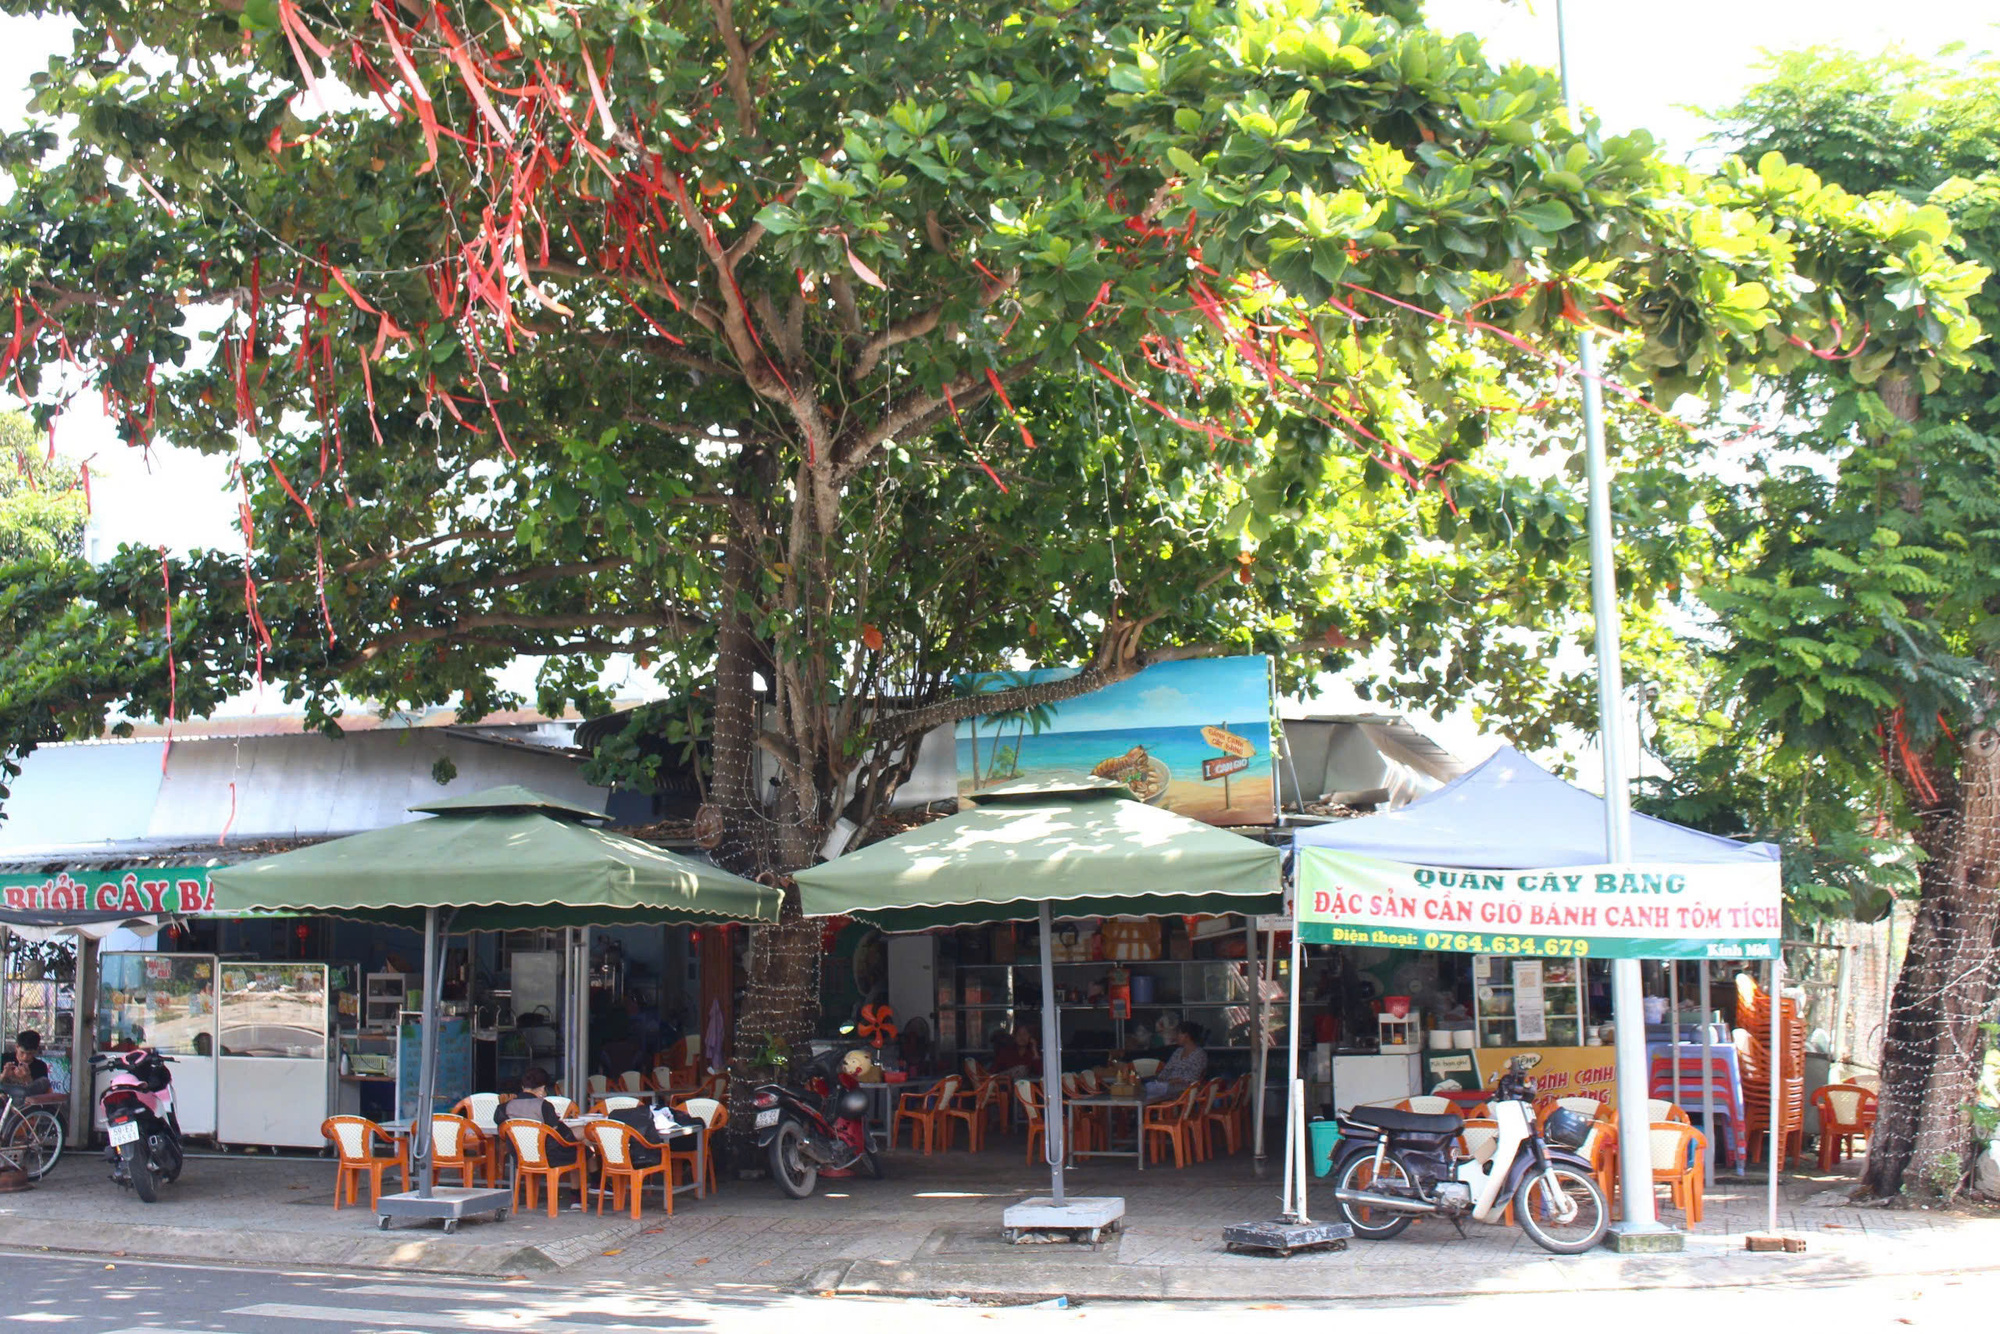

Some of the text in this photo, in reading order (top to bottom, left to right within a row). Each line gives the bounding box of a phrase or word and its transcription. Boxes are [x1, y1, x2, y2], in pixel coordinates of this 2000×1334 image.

[96, 876, 167, 911] CÂY
[1413, 867, 1686, 894] QUÁN CÂY BÀNG
[1314, 886, 1363, 919] ĐẶC
[1369, 887, 1417, 918] SẢN
[1424, 890, 1473, 922] CẦN
[1529, 901, 1597, 926] BÁNH
[1604, 905, 1669, 927] CANH
[1676, 901, 1722, 929] TÔM
[1727, 901, 1780, 928] TÍCH
[1332, 927, 1589, 956] Điện thoại: 0764.634.679
[1706, 943, 1743, 957] Kính
[1574, 1064, 1617, 1087] CANH
